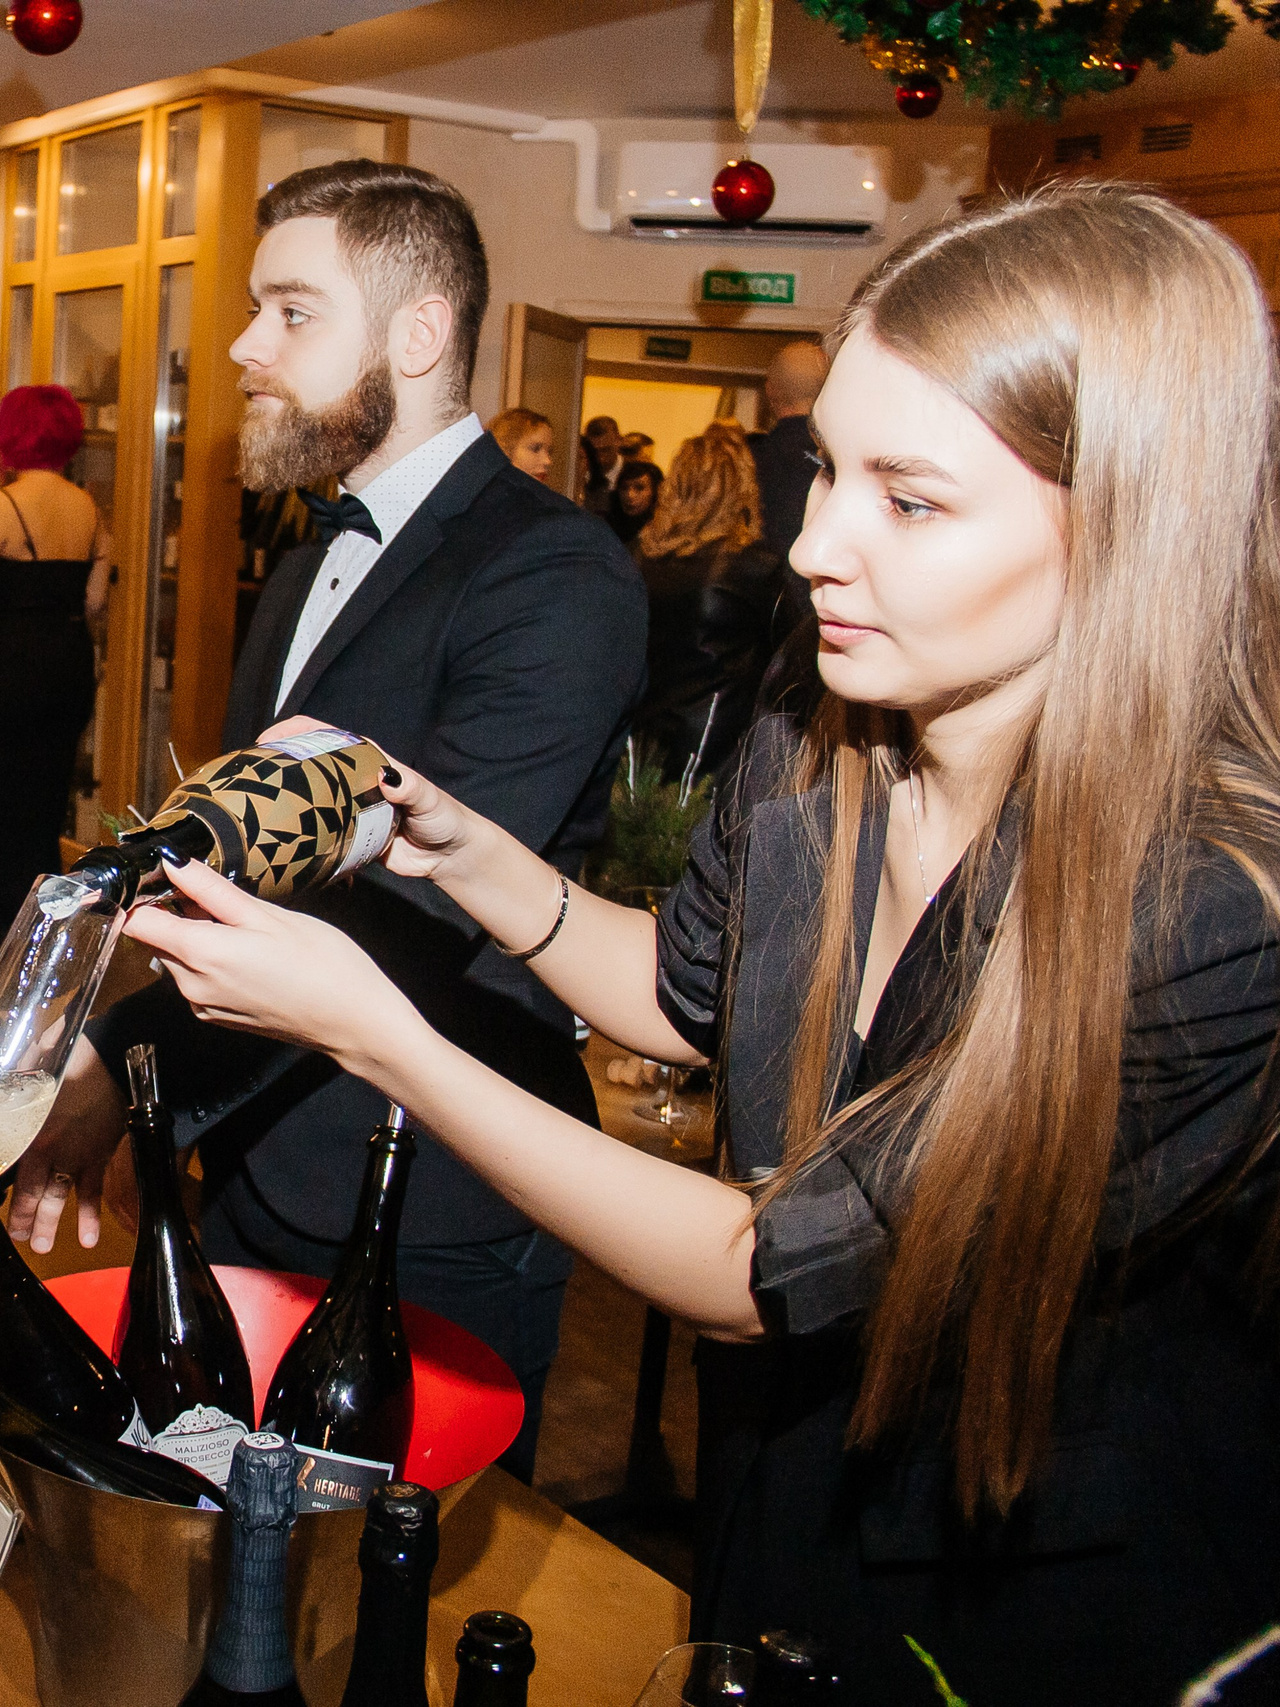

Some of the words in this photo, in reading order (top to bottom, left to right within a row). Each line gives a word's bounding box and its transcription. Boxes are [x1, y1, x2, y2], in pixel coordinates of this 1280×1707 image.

[709, 275, 788, 298] ВЫХОД
[174, 1438, 230, 1455] MALIZIOSO
[177, 1448, 231, 1464] PROSECCO
[311, 1501, 331, 1510] BRUT
